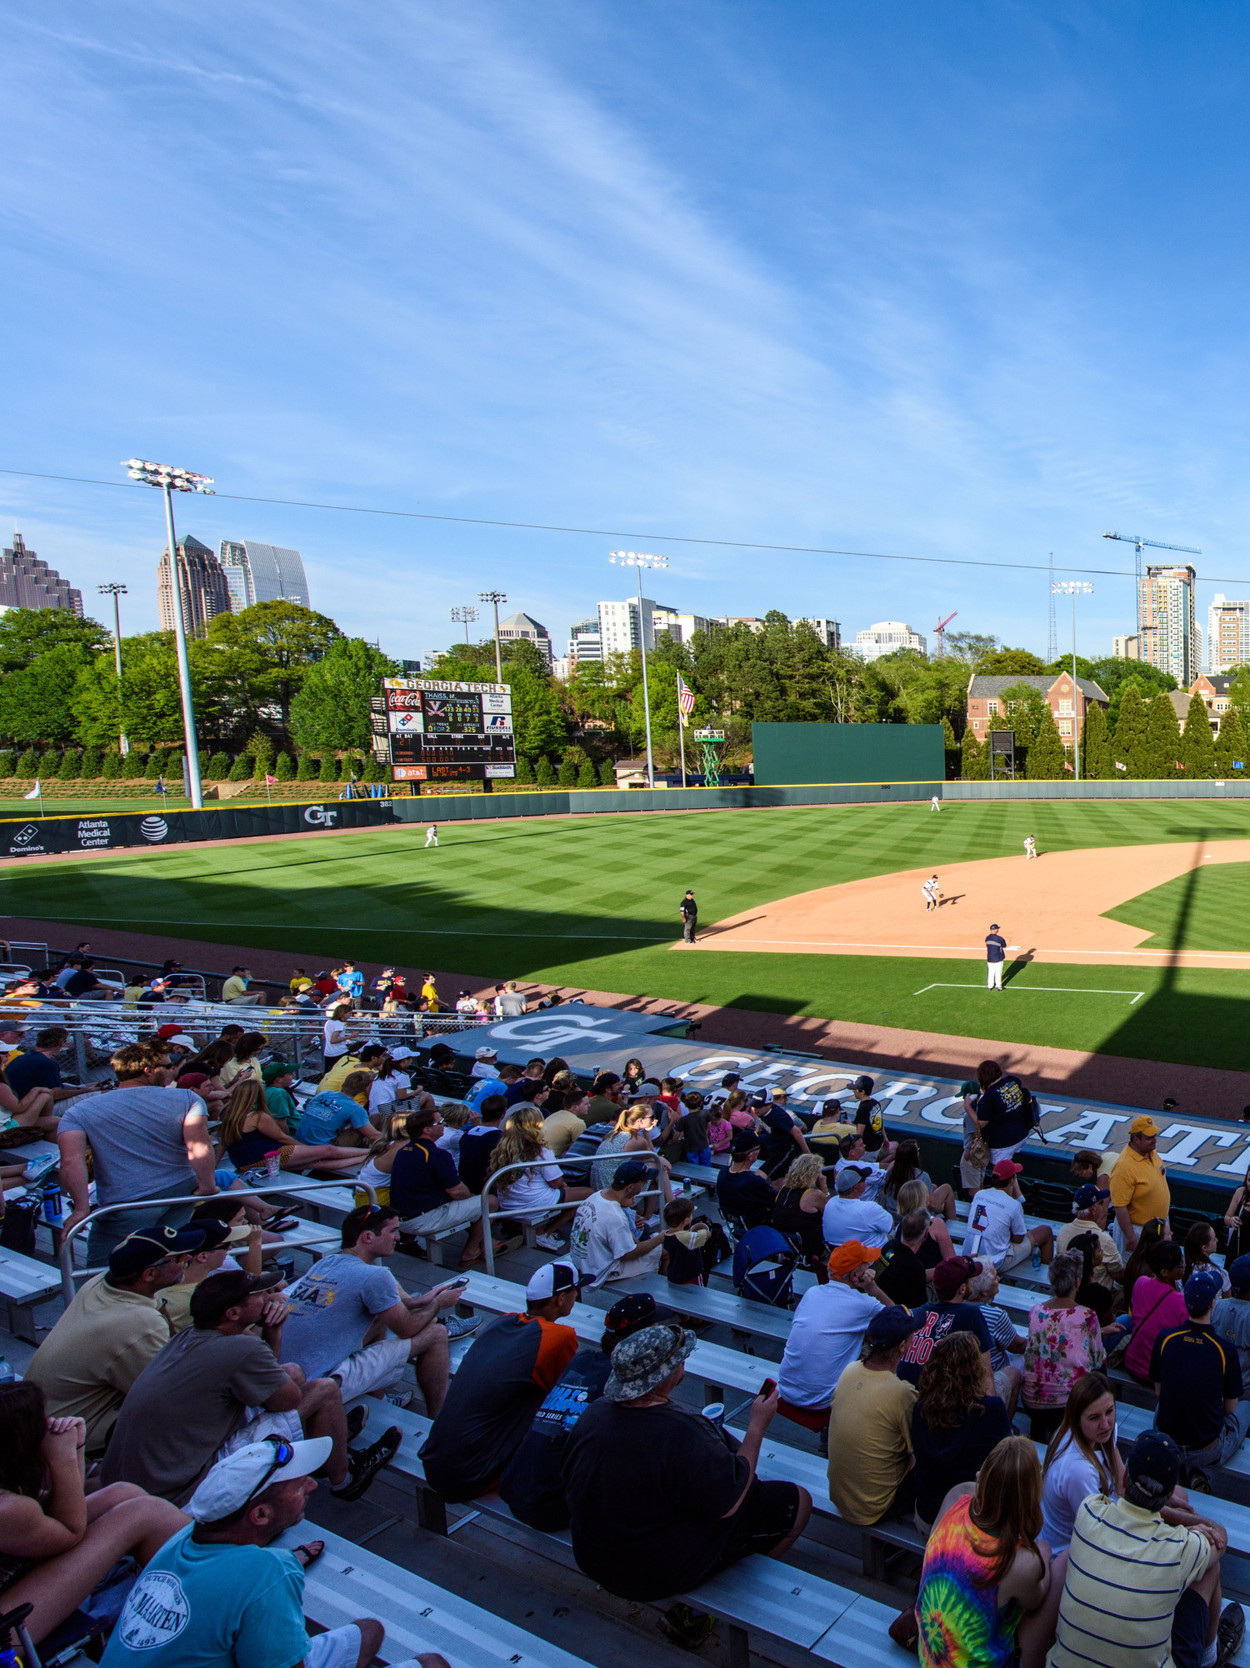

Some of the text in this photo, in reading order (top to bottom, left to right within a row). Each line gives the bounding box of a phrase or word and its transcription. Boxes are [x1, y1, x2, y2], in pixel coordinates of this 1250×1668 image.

[407, 680, 462, 691] GEORGIA
[465, 683, 497, 693] TECH
[389, 692, 420, 707] Coca-Cola
[304, 805, 337, 826] GT
[78, 820, 108, 829] Atlanta
[77, 828, 111, 838] Medical
[81, 838, 109, 847] Center
[10, 844, 44, 853] Domino's
[489, 1014, 624, 1052] GT
[134, 1593, 187, 1632] MAARTEN
[138, 1637, 156, 1646] 1493
